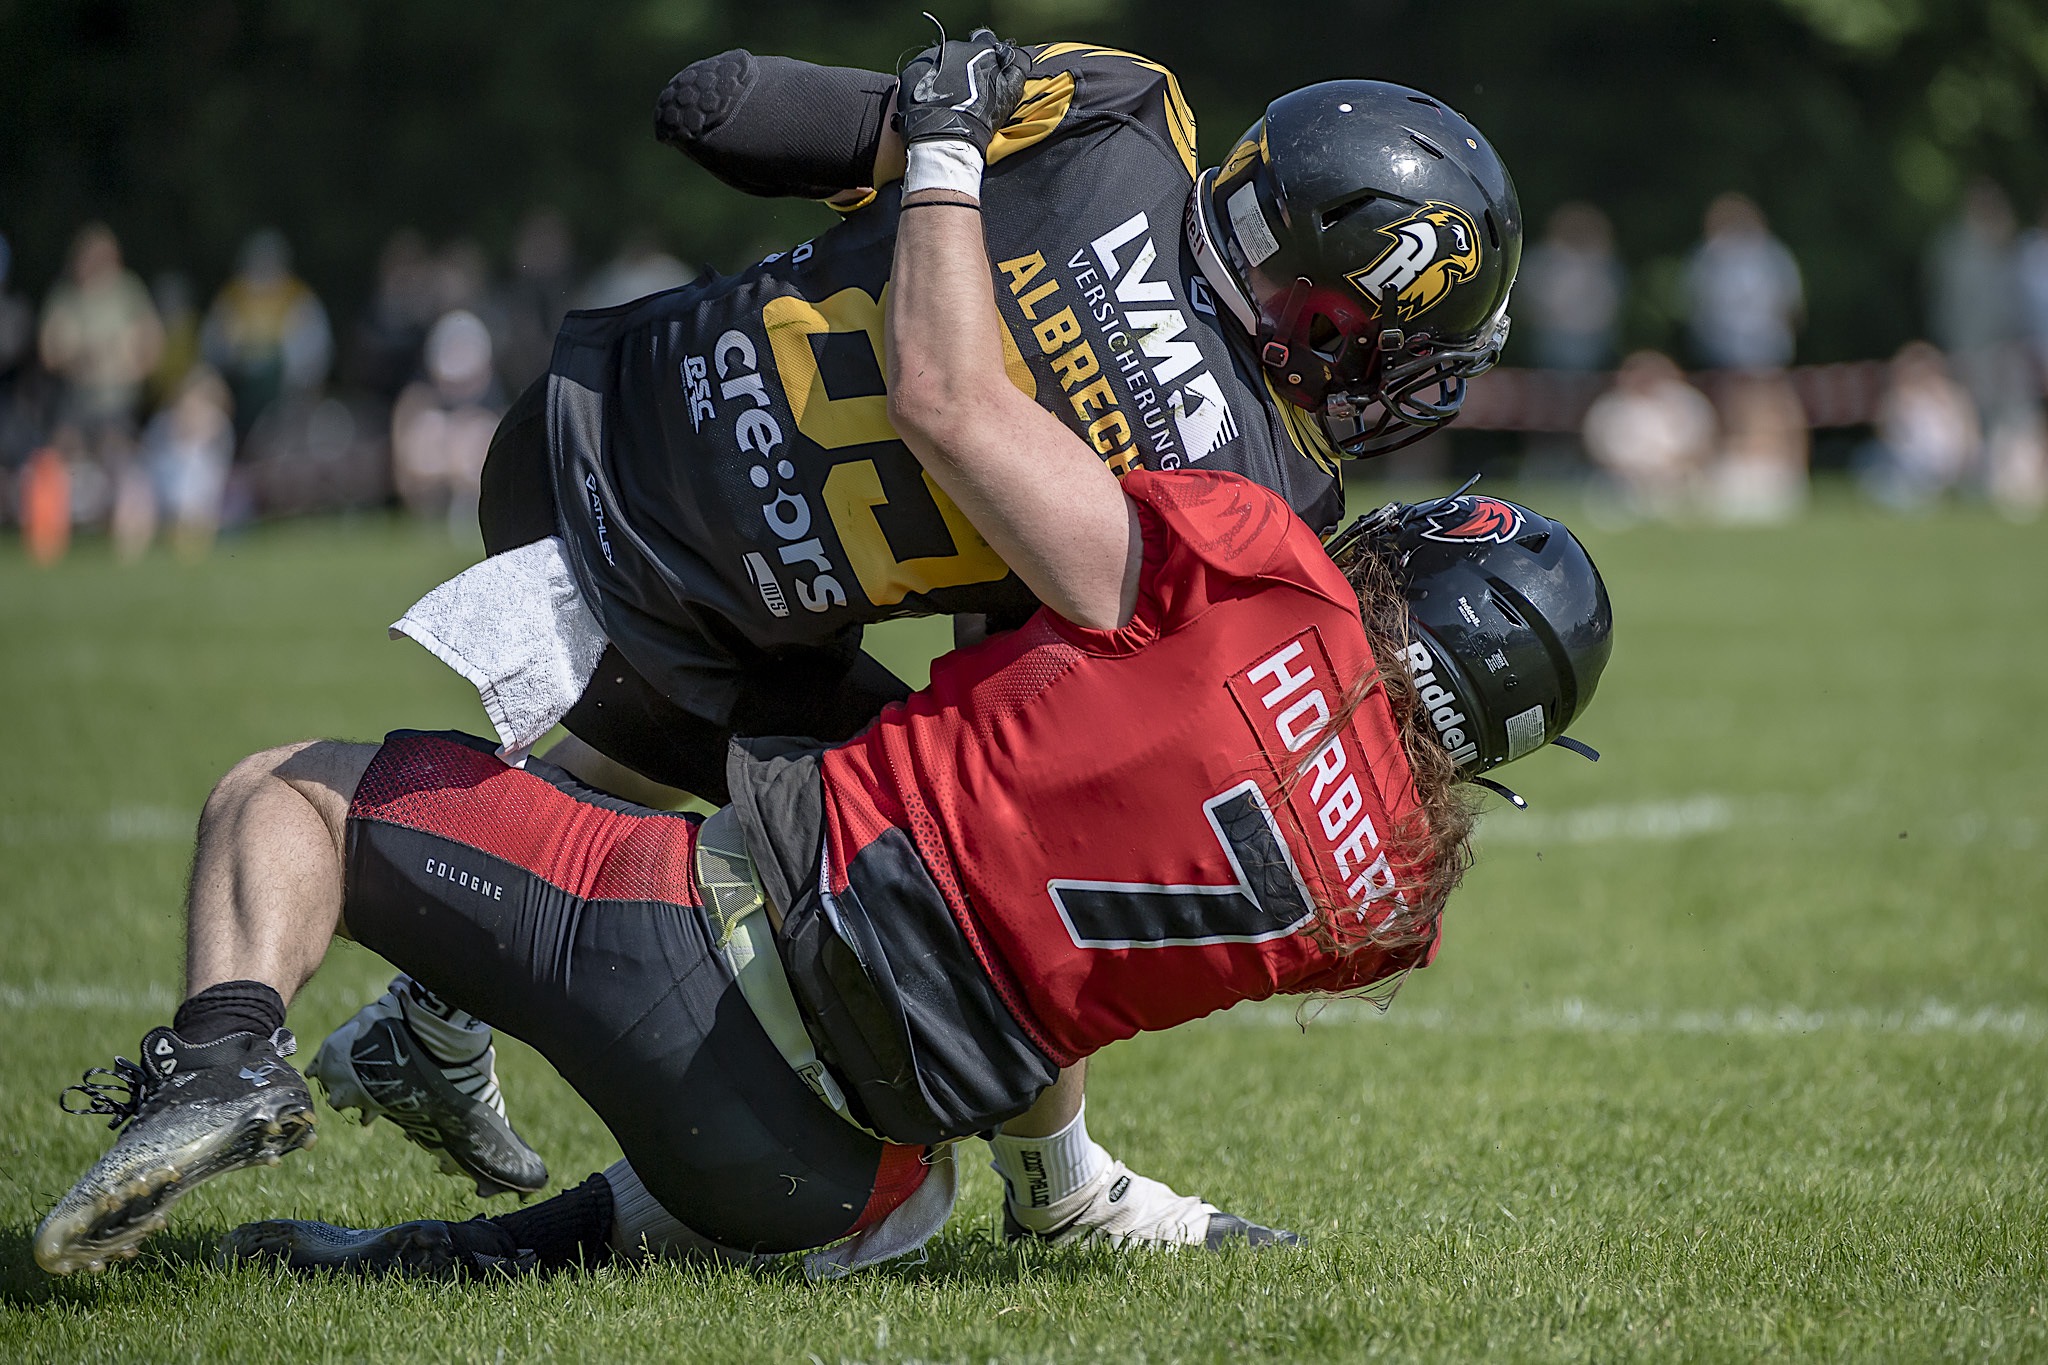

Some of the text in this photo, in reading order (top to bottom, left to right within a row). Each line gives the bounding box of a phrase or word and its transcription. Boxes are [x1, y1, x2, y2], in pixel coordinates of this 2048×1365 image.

[1067, 248, 1181, 471] VERSICHERUNG
[1090, 211, 1203, 386] LVM
[687, 355, 716, 421] RSC
[1395, 641, 1478, 766] Riddell
[426, 858, 503, 901] COLOGNE
[1047, 780, 1315, 948] 7
